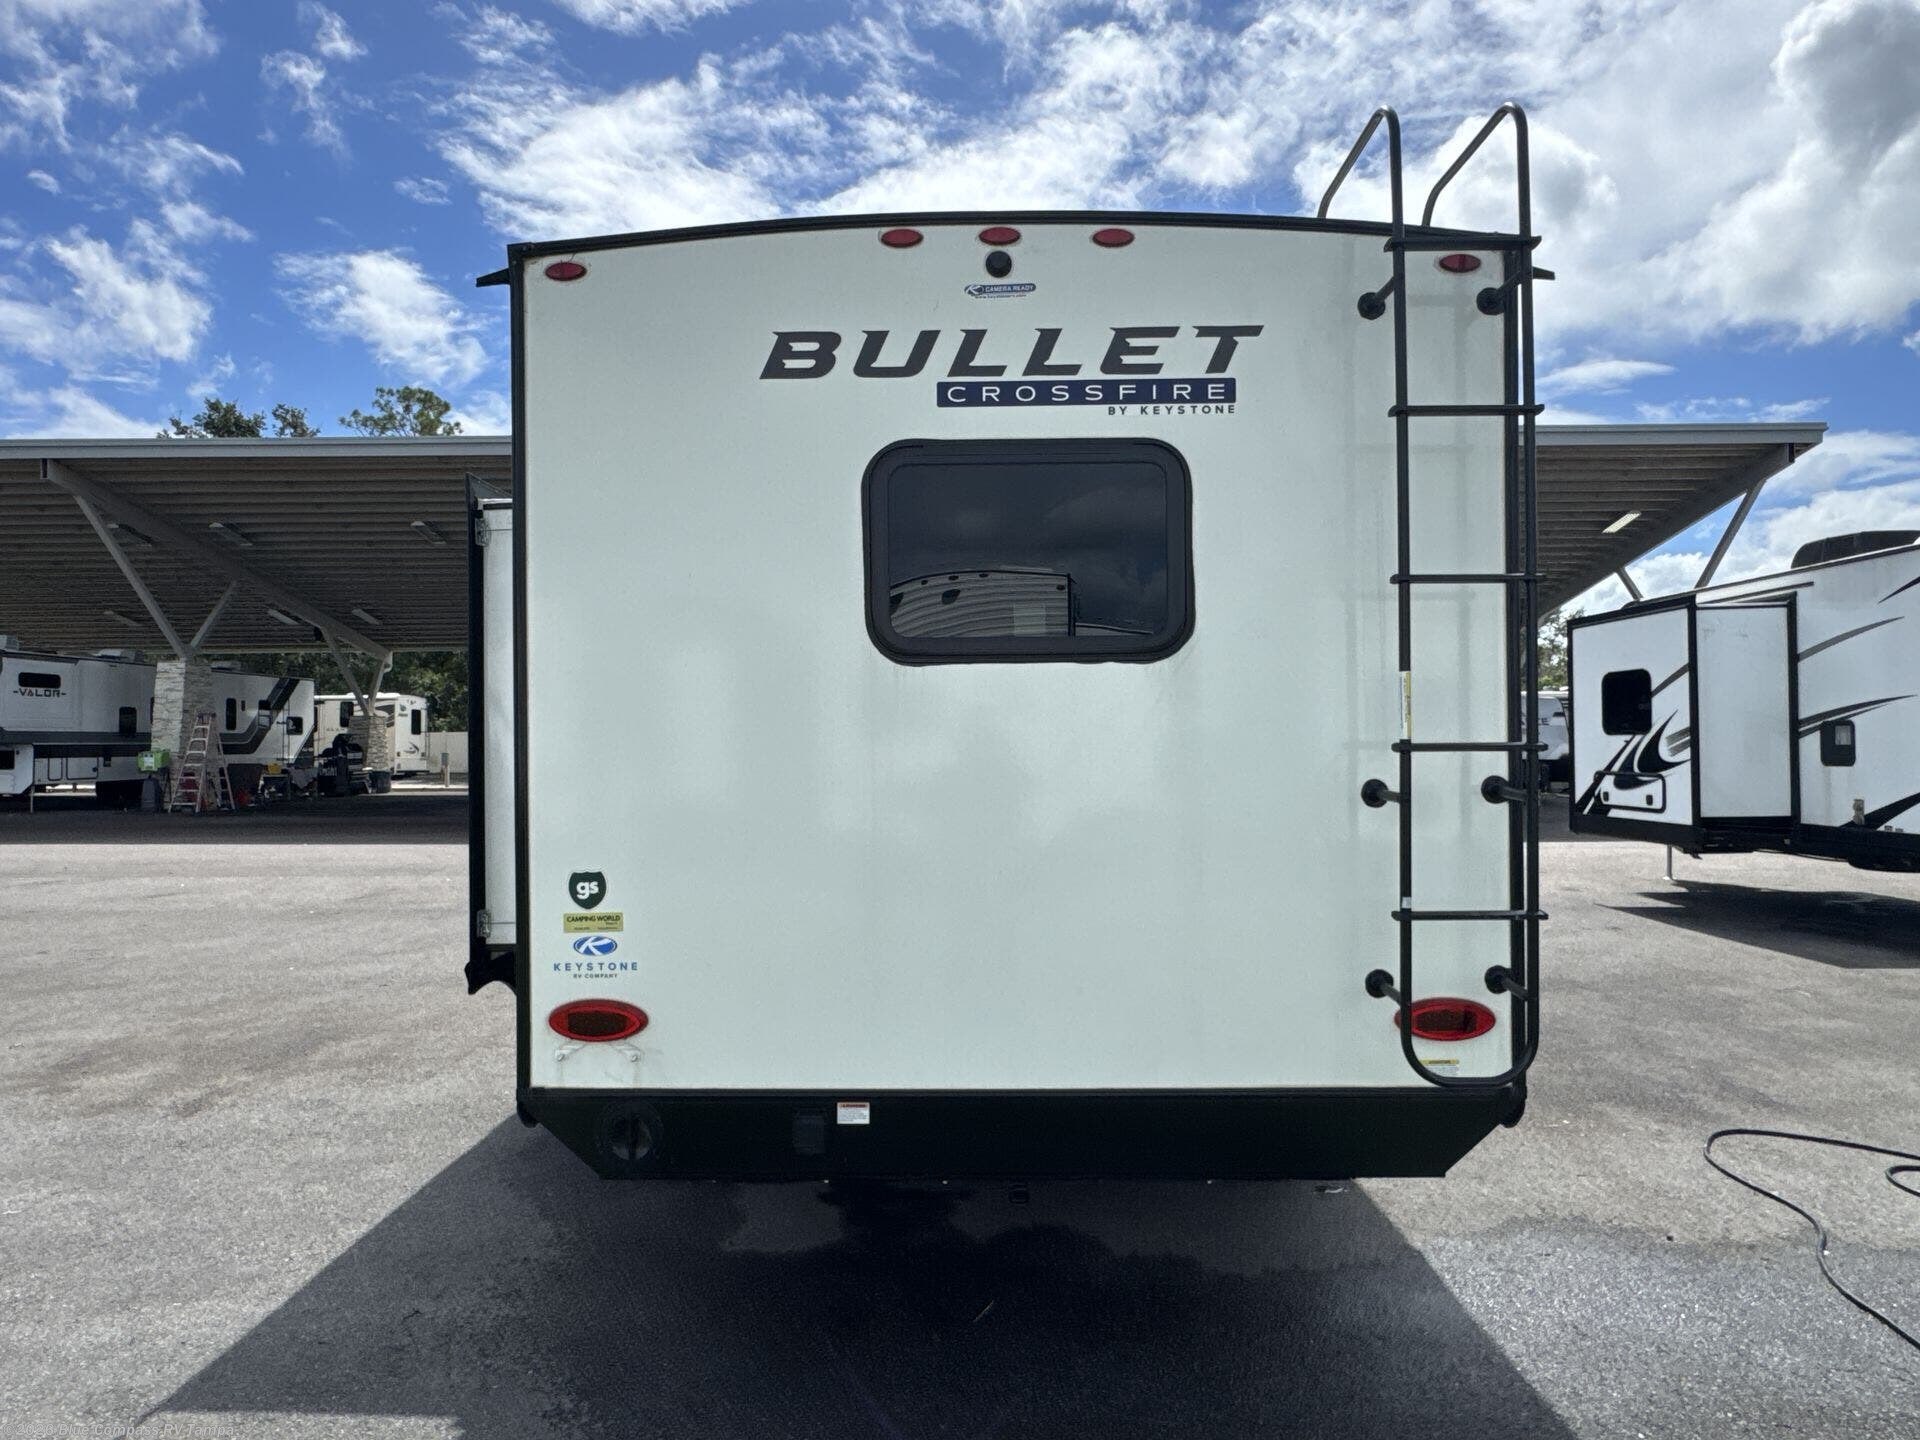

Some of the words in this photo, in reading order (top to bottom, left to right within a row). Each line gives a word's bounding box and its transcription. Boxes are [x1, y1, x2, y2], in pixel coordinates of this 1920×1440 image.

[985, 285, 1012, 293] CAMERA
[1012, 284, 1034, 292] READY
[759, 325, 1265, 380] BULLET
[947, 383, 1226, 403] CROSSFIRE
[1107, 406, 1128, 416] BY
[1140, 404, 1236, 416] KEYSTONE
[576, 881, 600, 900] gs
[566, 915, 597, 923] CAMPING
[597, 914, 621, 922] WORLD
[553, 961, 638, 971] KEYSTONE
